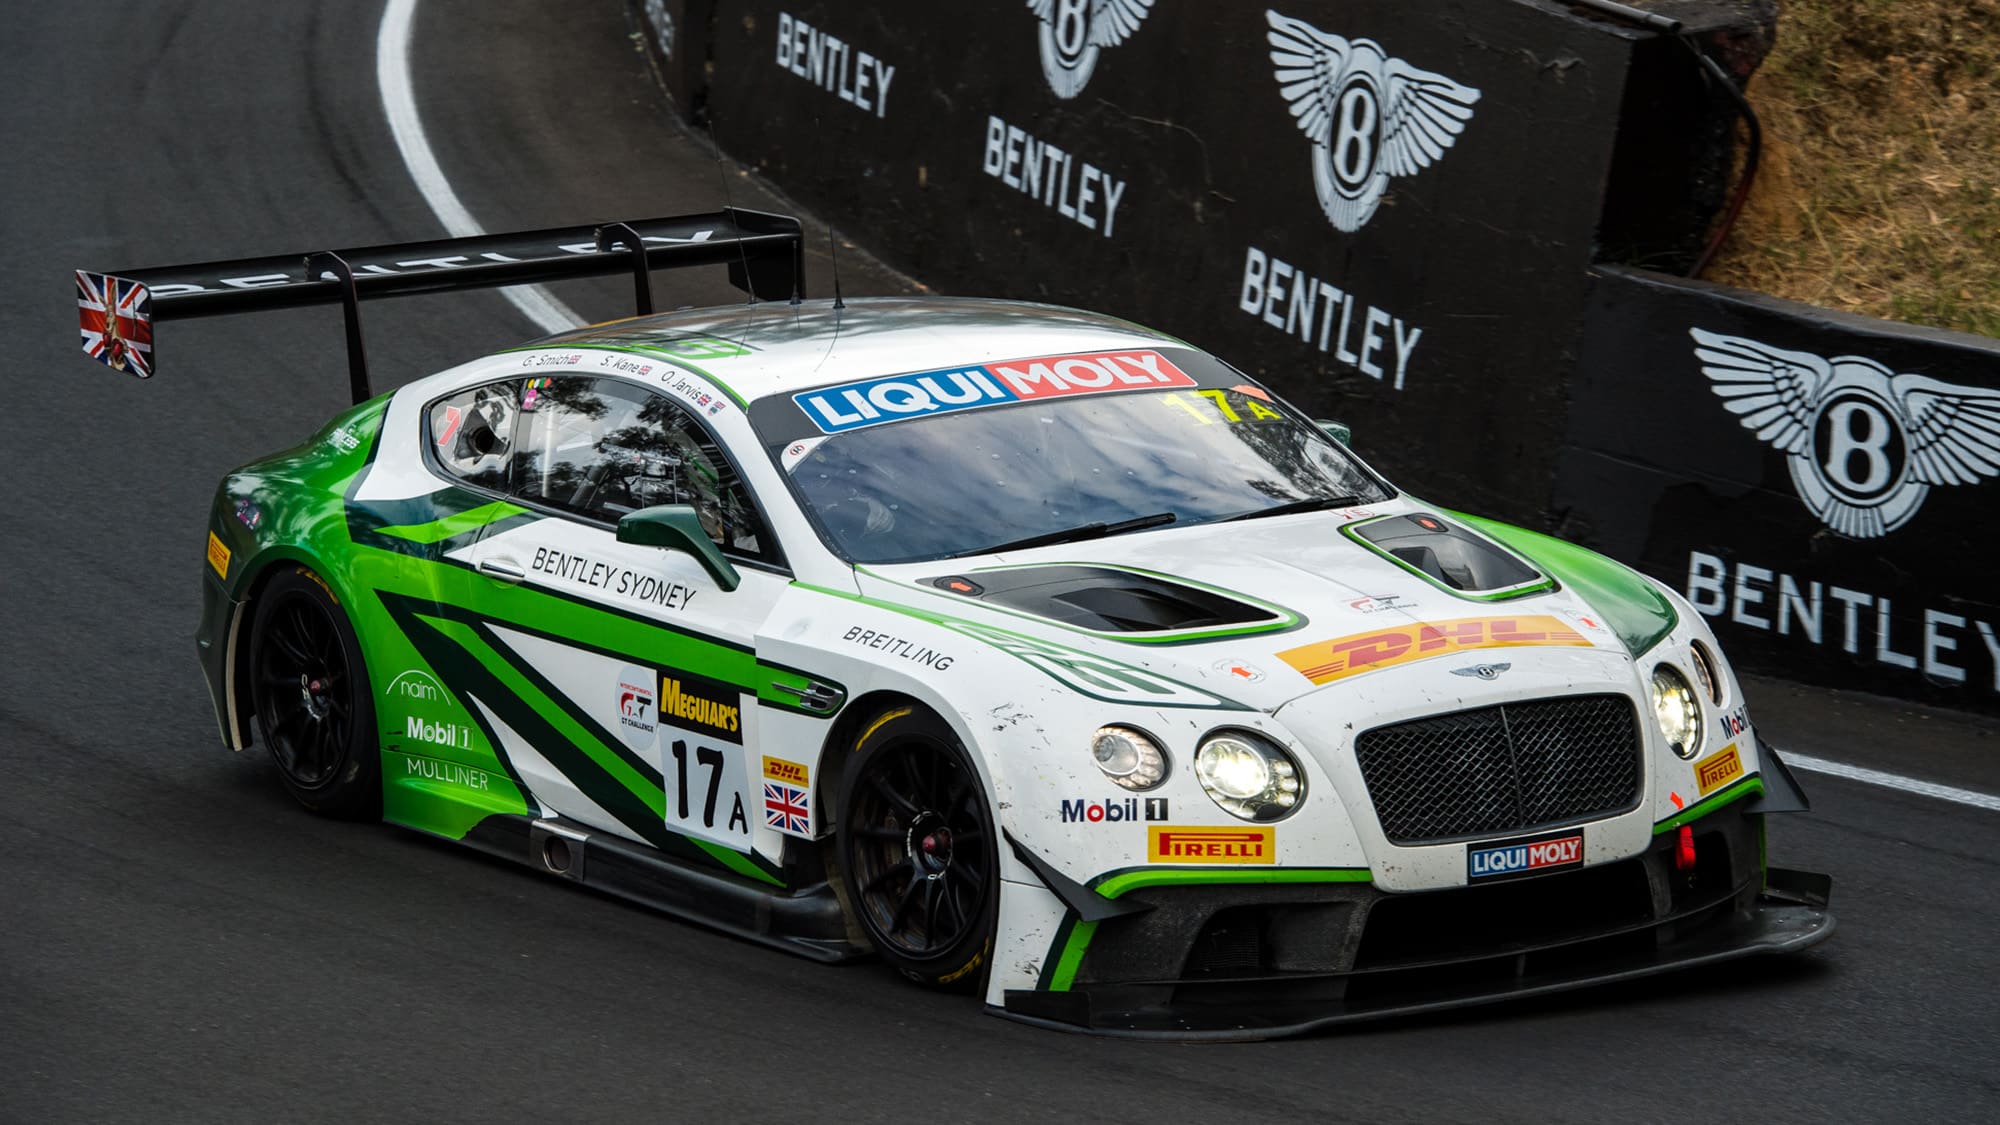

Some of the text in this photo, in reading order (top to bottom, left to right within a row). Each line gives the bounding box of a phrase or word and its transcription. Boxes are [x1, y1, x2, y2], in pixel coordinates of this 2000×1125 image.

[776, 12, 895, 118] BENTLEY
[983, 115, 1126, 237] BENTLEY
[1240, 247, 1422, 390] BENTLEY
[600, 355, 640, 374] S. Kane
[674, 376, 702, 402] Jarvis
[808, 355, 1172, 427] LIQUI MOLY
[532, 547, 697, 611] BENTLEY SYDNEY
[1688, 551, 2000, 692] BENTLEY
[843, 626, 954, 671] BREITLING
[1332, 620, 1547, 668] DHL
[401, 680, 437, 701] naim
[661, 677, 738, 732] MEGUIAR'S
[407, 716, 456, 747] Mobil
[628, 719, 654, 733] CHALLENGE
[407, 758, 488, 791] MULLINER
[770, 761, 803, 781] DHL
[1699, 751, 1738, 788] PIRELLI
[1062, 798, 1164, 822] Mobil 1
[1159, 833, 1264, 857] PIRELLI
[1473, 840, 1580, 873] LIQUI MOLY
